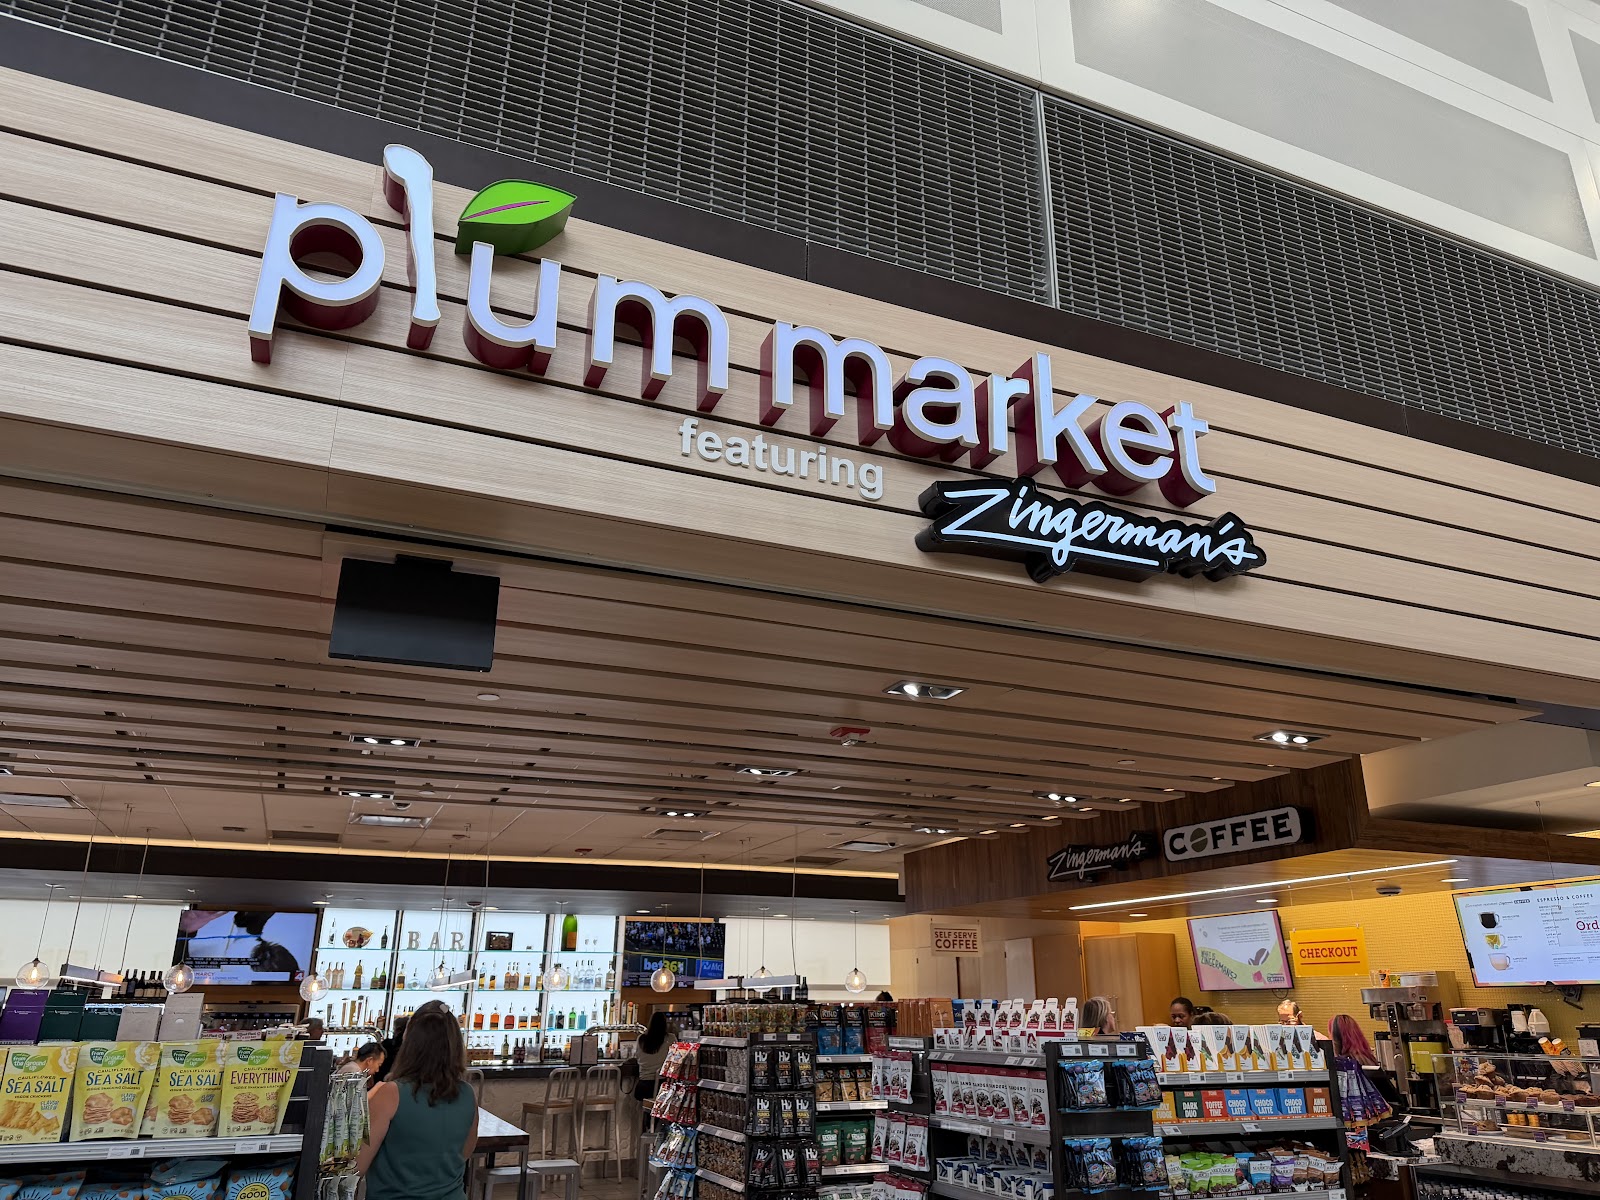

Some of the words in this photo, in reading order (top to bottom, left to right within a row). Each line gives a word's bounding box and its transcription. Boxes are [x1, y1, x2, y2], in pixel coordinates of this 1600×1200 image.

[248, 144, 730, 394] plum
[771, 351, 1217, 495] market
[678, 418, 884, 500] featuring
[940, 485, 1259, 567] Zingerman's
[1050, 834, 1146, 879] Zingerman's
[1168, 812, 1293, 855] COFFEE
[935, 938, 978, 950] COFFEE
[1300, 946, 1358, 959] CHECKOUT
[86, 1072, 112, 1086] SEA
[115, 1070, 144, 1086] SALT
[170, 1072, 192, 1086] SEA
[196, 1072, 224, 1086] SALT
[230, 1070, 292, 1084] EVERYTHING
[6, 1078, 31, 1094] SEA
[34, 1078, 66, 1092] SALT
[1182, 1102, 1198, 1110] DARK
[1206, 1101, 1224, 1109] TOFFEE
[1228, 1100, 1246, 1108] CHOCO
[1254, 1098, 1274, 1107] CHOCO
[1284, 1098, 1302, 1106] CHOCO
[1209, 1108, 1222, 1116] TIME
[1231, 1106, 1246, 1115] LATTE
[1258, 1106, 1274, 1114] LATTE
[1313, 1105, 1328, 1113] NUTS!
[1156, 1110, 1172, 1118] FUDGE
[1184, 1110, 1197, 1118] DUO
[240, 1190, 266, 1200] GOOD
